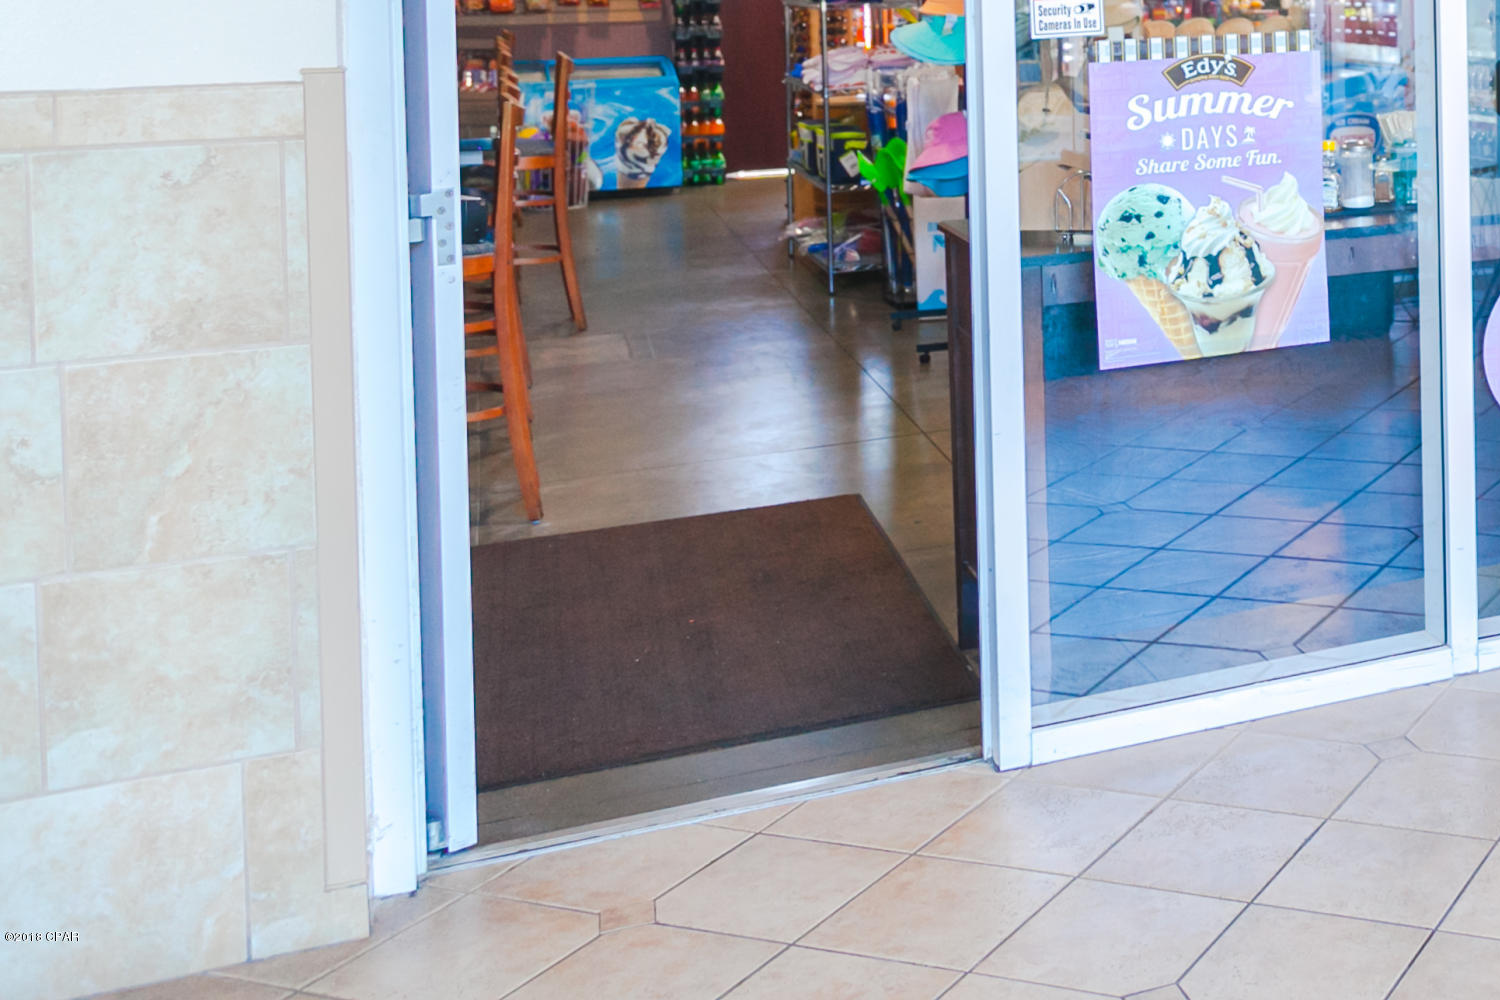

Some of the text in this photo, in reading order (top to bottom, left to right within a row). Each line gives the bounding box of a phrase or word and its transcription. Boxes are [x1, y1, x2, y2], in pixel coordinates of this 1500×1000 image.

[1037, 4, 1072, 18] Security
[1038, 17, 1097, 32] Cameras In Use
[1181, 54, 1237, 79] Edy's
[1126, 91, 1295, 131] Summer
[1181, 124, 1238, 151] DAYS
[1136, 149, 1282, 176] Share Some Fun.
